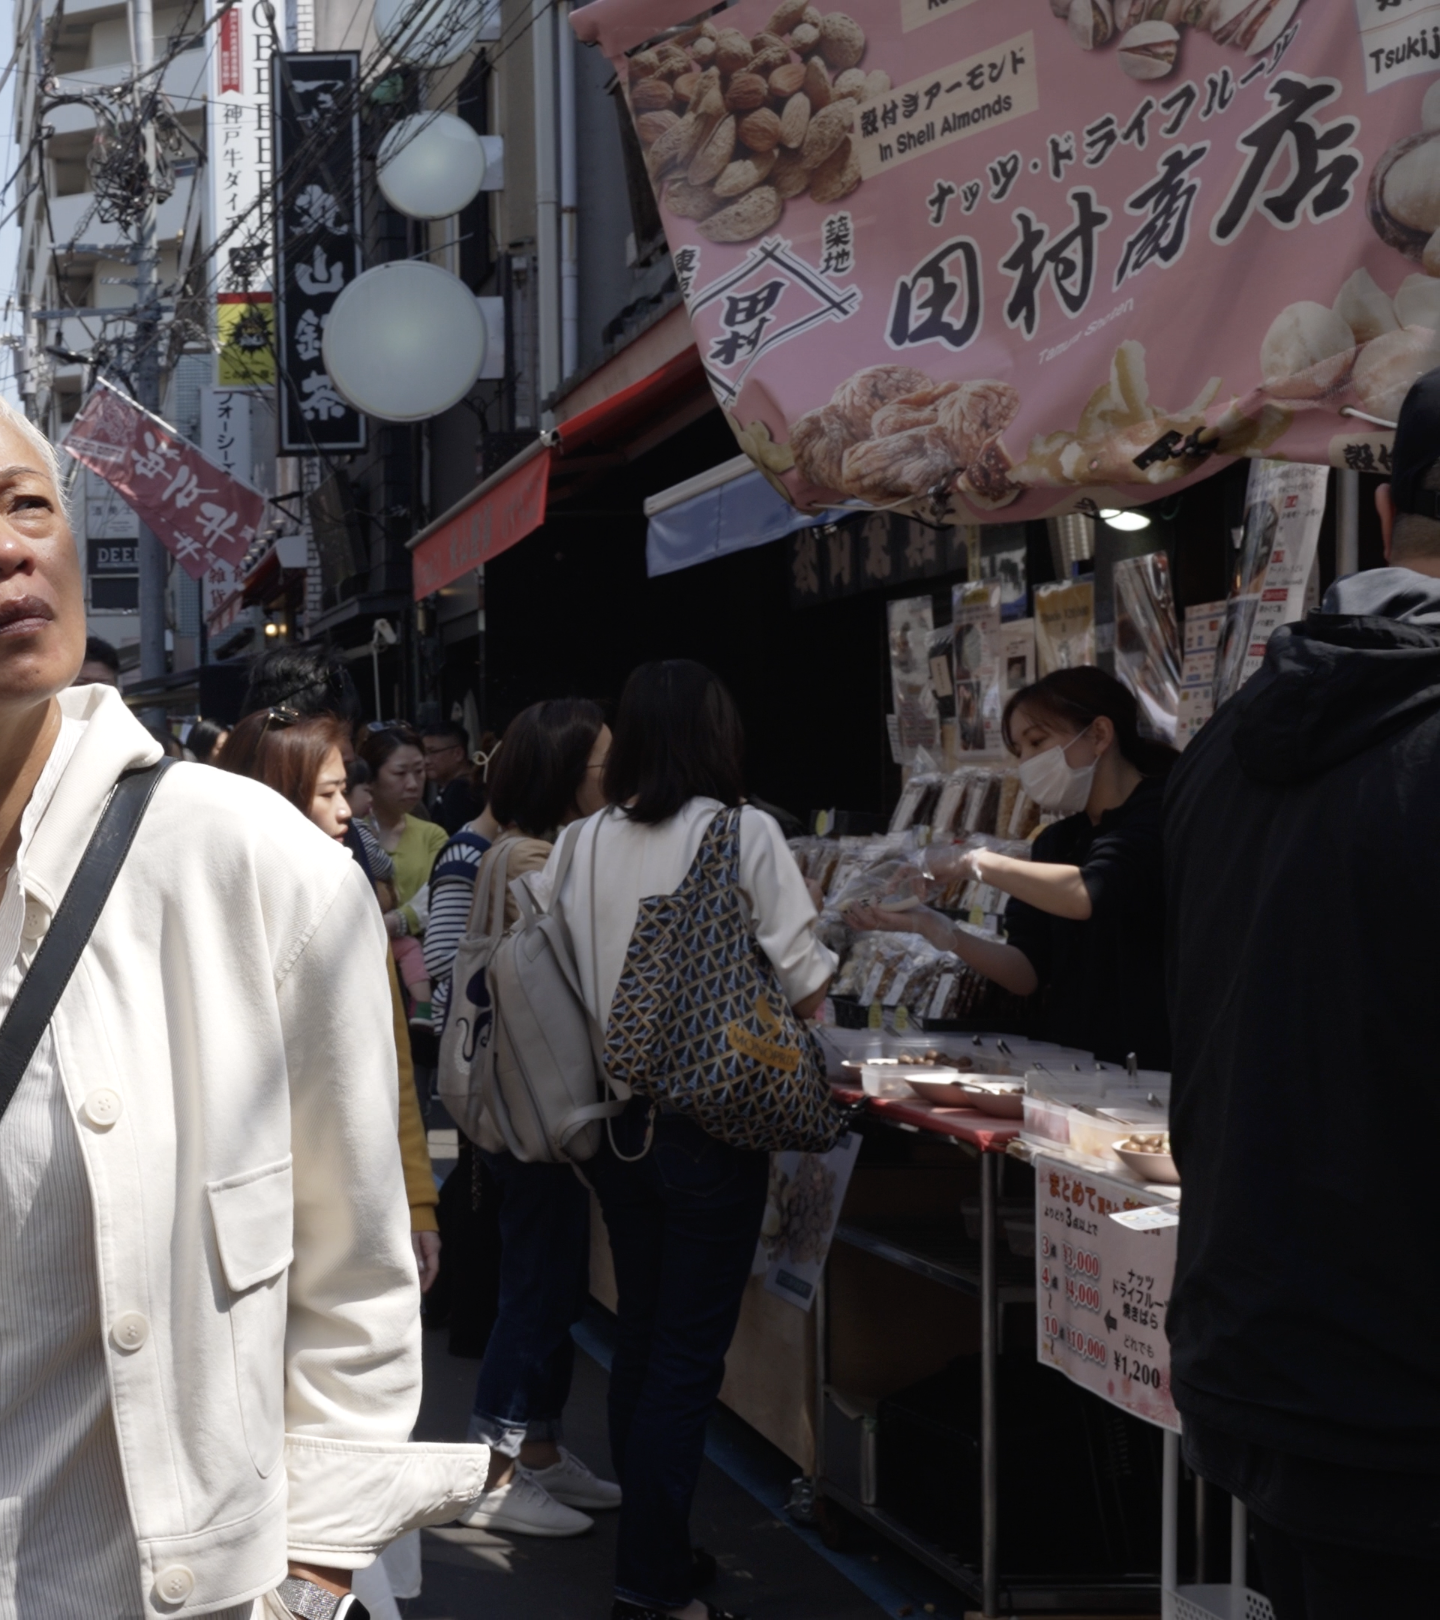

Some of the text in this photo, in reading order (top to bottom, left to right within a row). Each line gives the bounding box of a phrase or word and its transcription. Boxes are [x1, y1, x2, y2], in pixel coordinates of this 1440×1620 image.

[878, 93, 1013, 162] In Shell Almonds
[889, 77, 1360, 348] 田村商店
[820, 214, 851, 274] 築地
[710, 280, 786, 365] 田村
[98, 547, 140, 563] DEE
[1112, 1279, 1168, 1309] ドライフルー
[1126, 1269, 1155, 1290] ナッツ
[1112, 1350, 1160, 1389] ¥1,200
